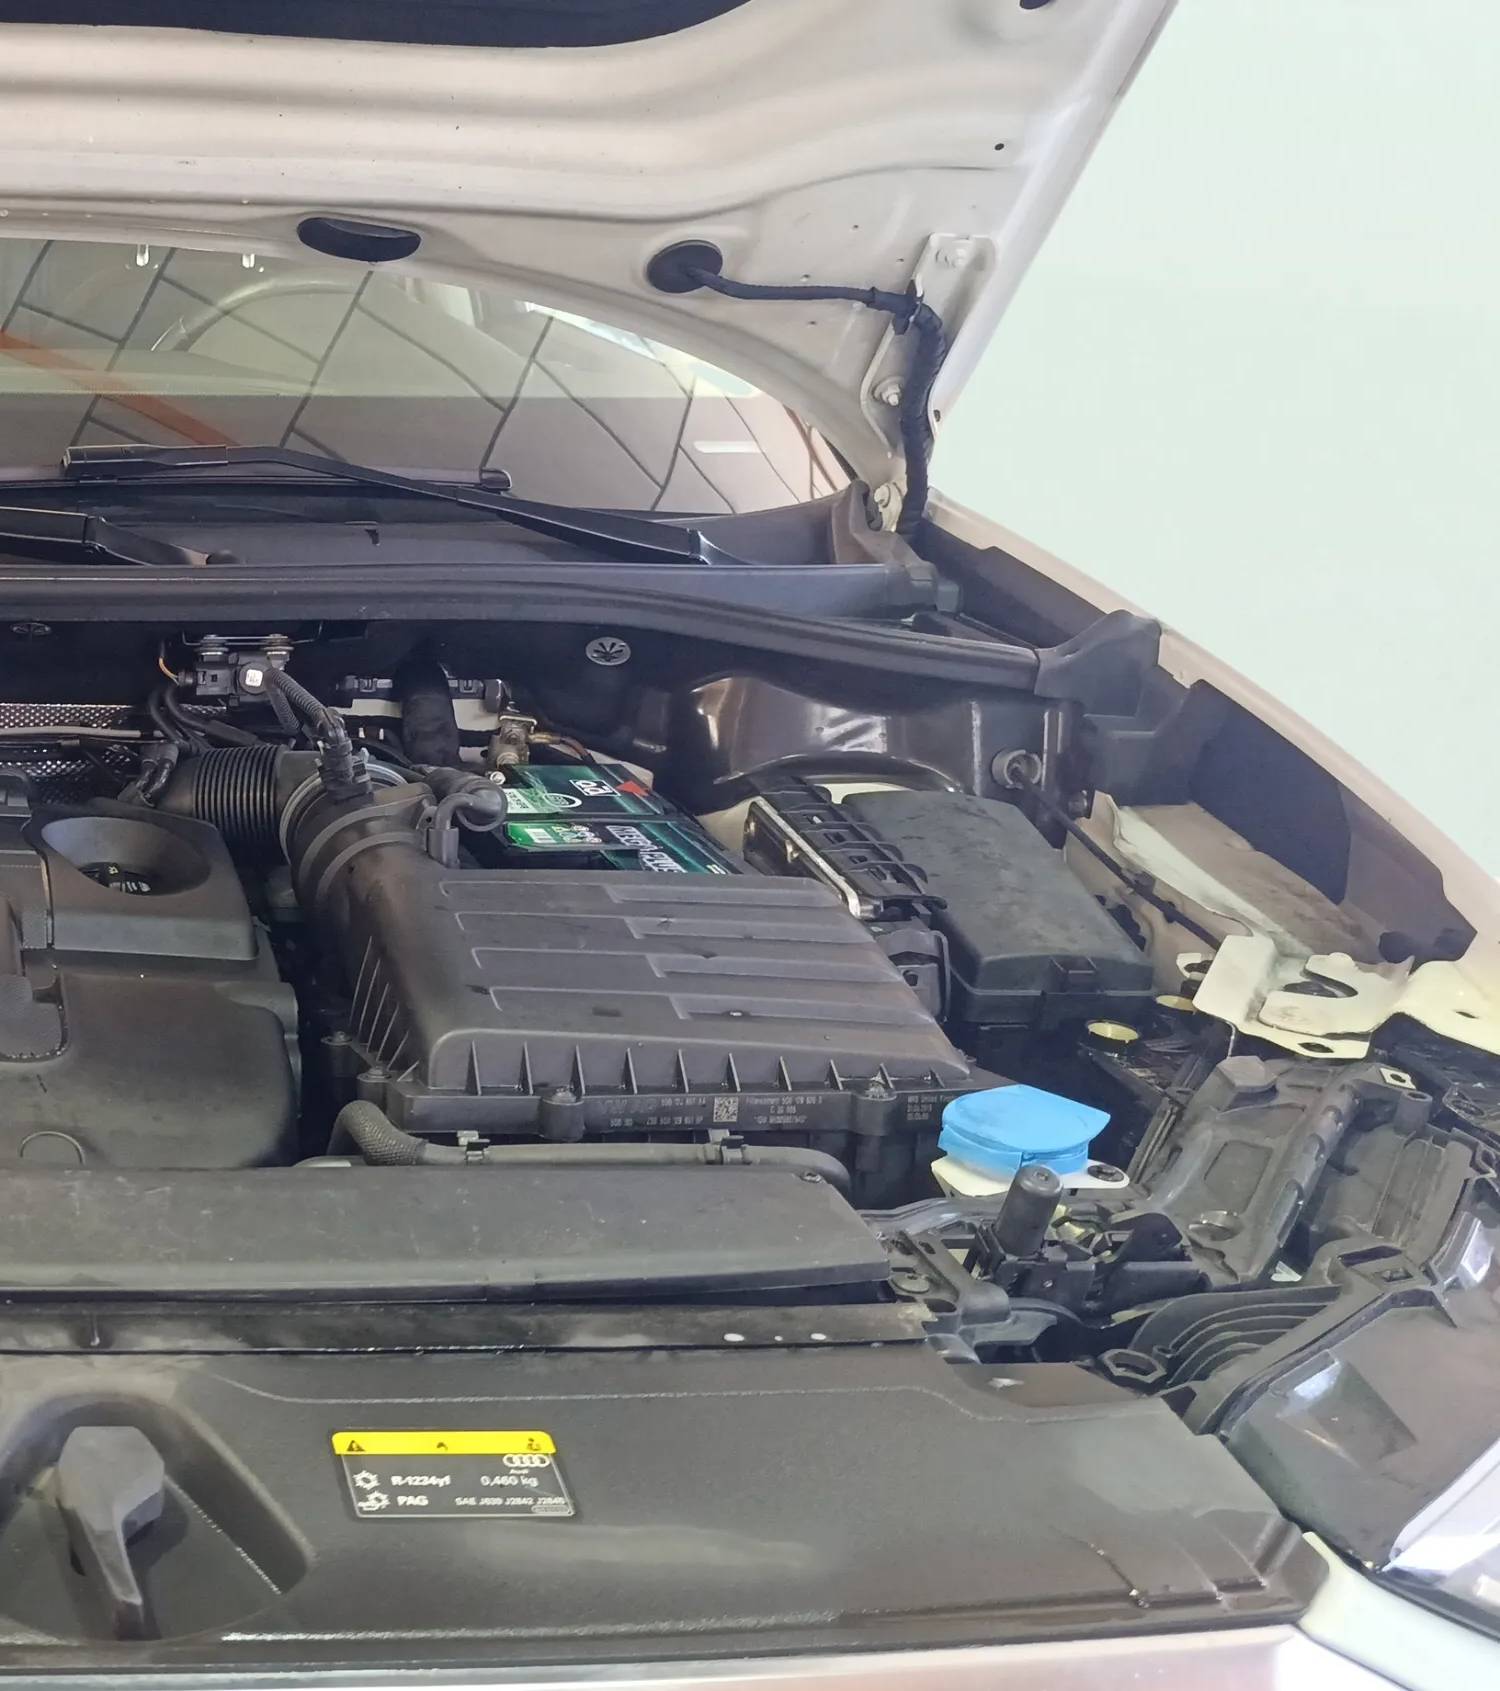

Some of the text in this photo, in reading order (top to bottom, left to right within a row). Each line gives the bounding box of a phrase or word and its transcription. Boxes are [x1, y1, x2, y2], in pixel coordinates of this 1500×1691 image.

[520, 1475, 539, 1488] kg
[396, 1495, 429, 1506] PAG
[455, 1497, 477, 1506] SAE
